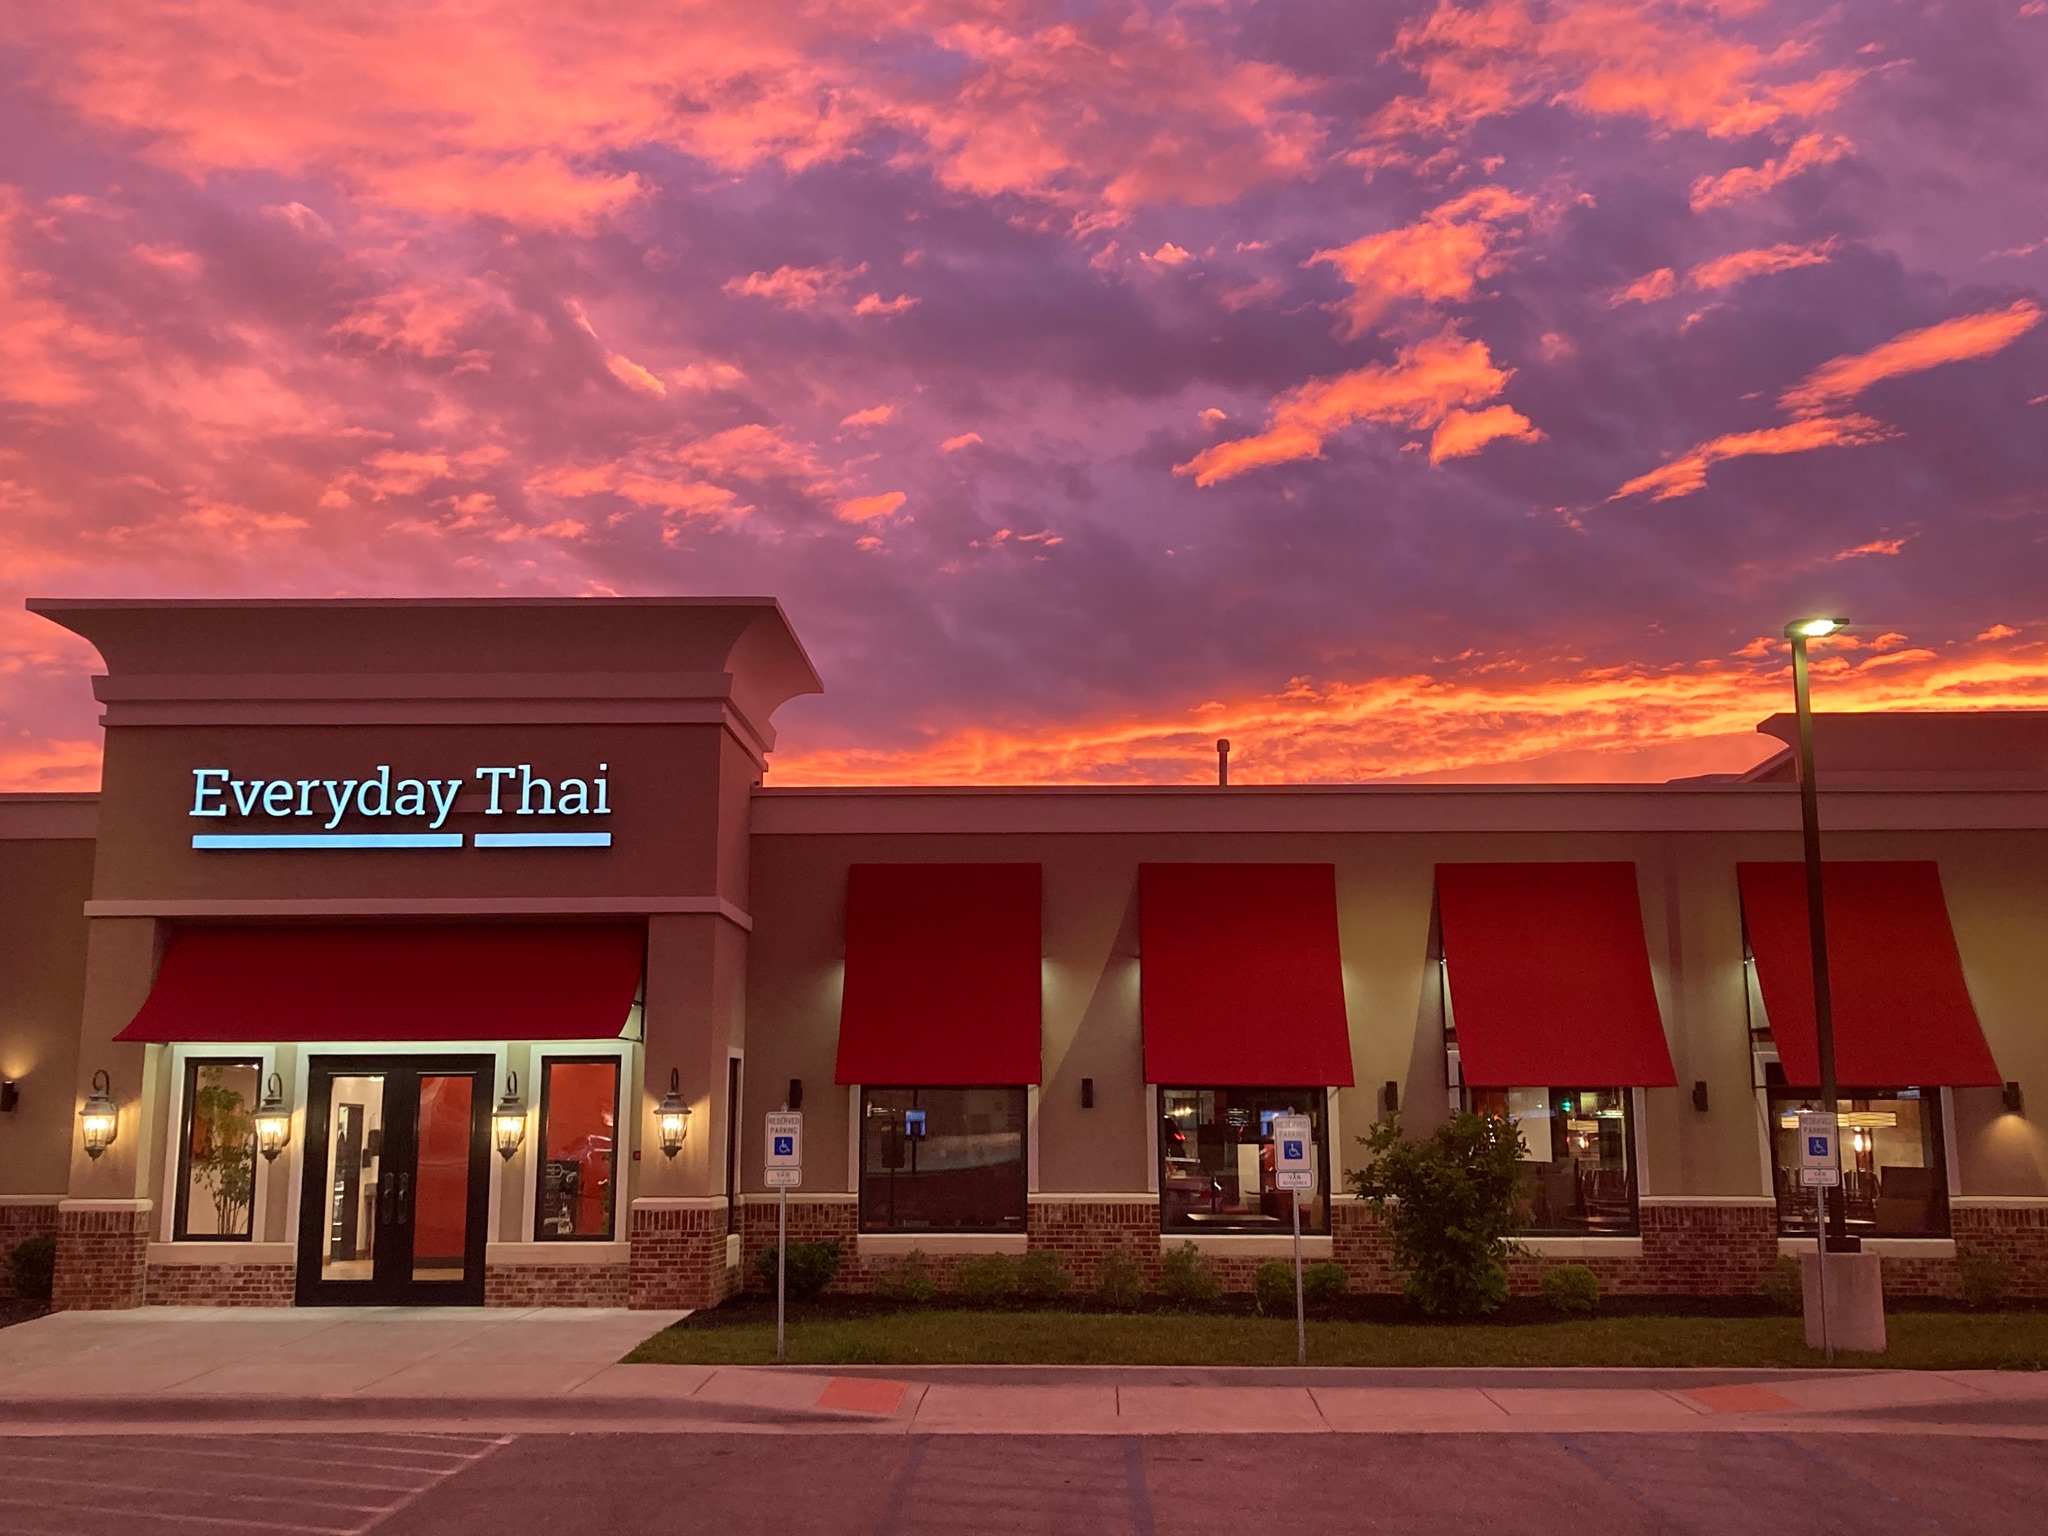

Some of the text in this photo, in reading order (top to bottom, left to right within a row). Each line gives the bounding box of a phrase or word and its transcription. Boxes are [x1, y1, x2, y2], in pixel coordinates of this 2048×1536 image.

[188, 763, 611, 829] Everyday Thai
[768, 1117, 800, 1125] RESERVED
[1277, 1121, 1308, 1129] RESERVED
[1278, 1130, 1306, 1138] PARKING
